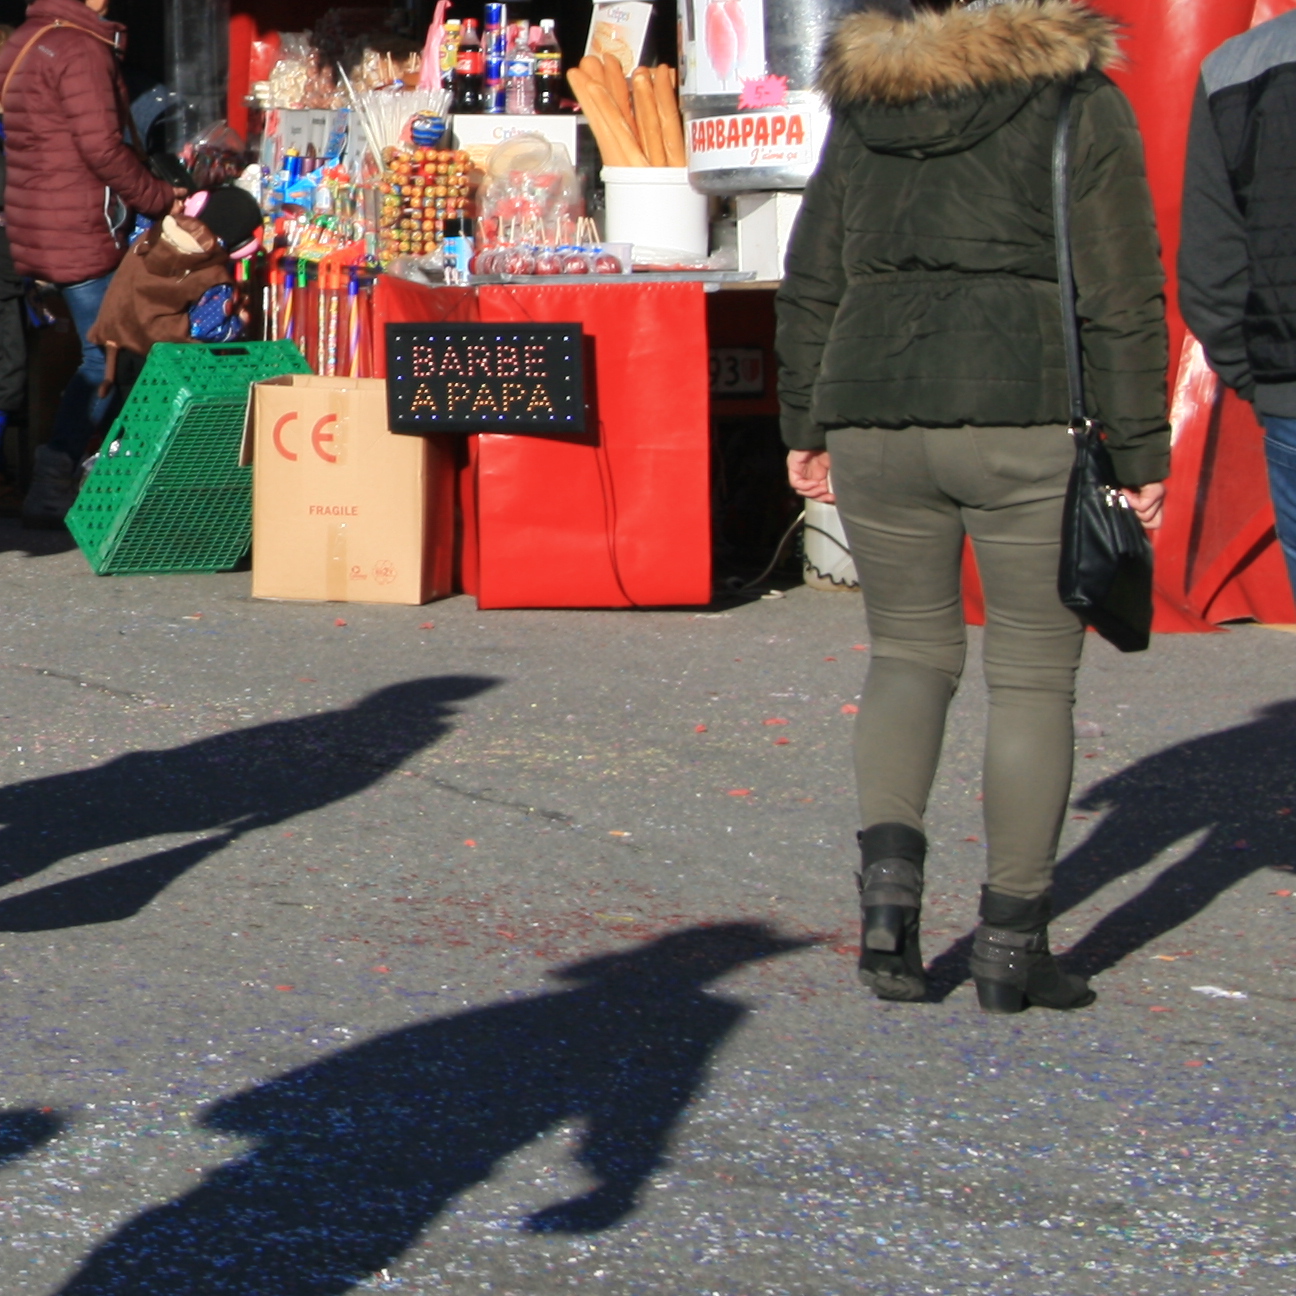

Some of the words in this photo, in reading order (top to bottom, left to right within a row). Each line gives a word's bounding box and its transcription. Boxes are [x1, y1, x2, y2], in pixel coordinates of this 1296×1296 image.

[691, 114, 805, 153] BARBAPAPA
[411, 344, 548, 378] BARBE
[410, 381, 437, 412] A
[446, 381, 554, 413] PAPA
[272, 410, 338, 464] CE
[309, 505, 359, 516] FRAGILE
